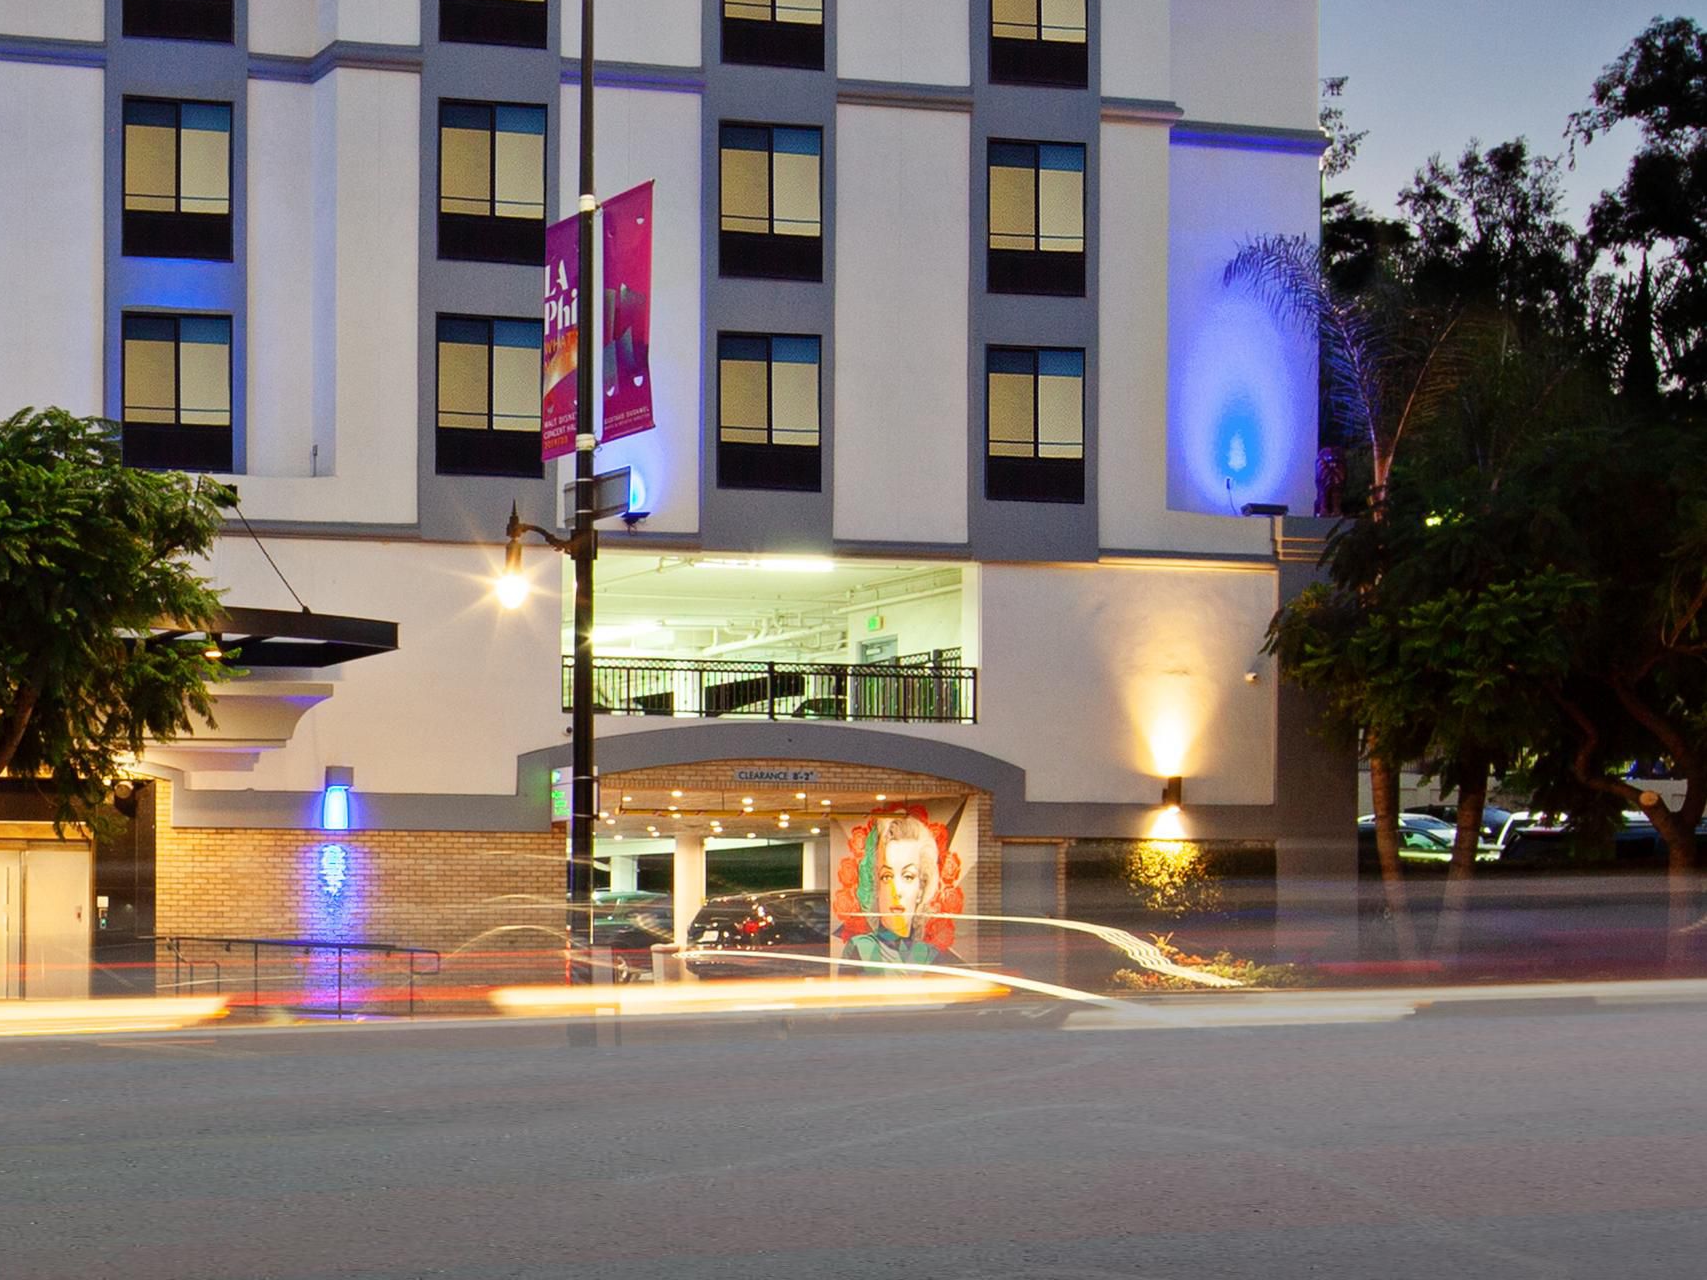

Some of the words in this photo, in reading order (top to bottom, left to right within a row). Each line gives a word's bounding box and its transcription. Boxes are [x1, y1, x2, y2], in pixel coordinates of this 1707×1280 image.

[544, 259, 569, 298] LA
[543, 288, 579, 336] Phi
[738, 771, 787, 780] CLEARANCE
